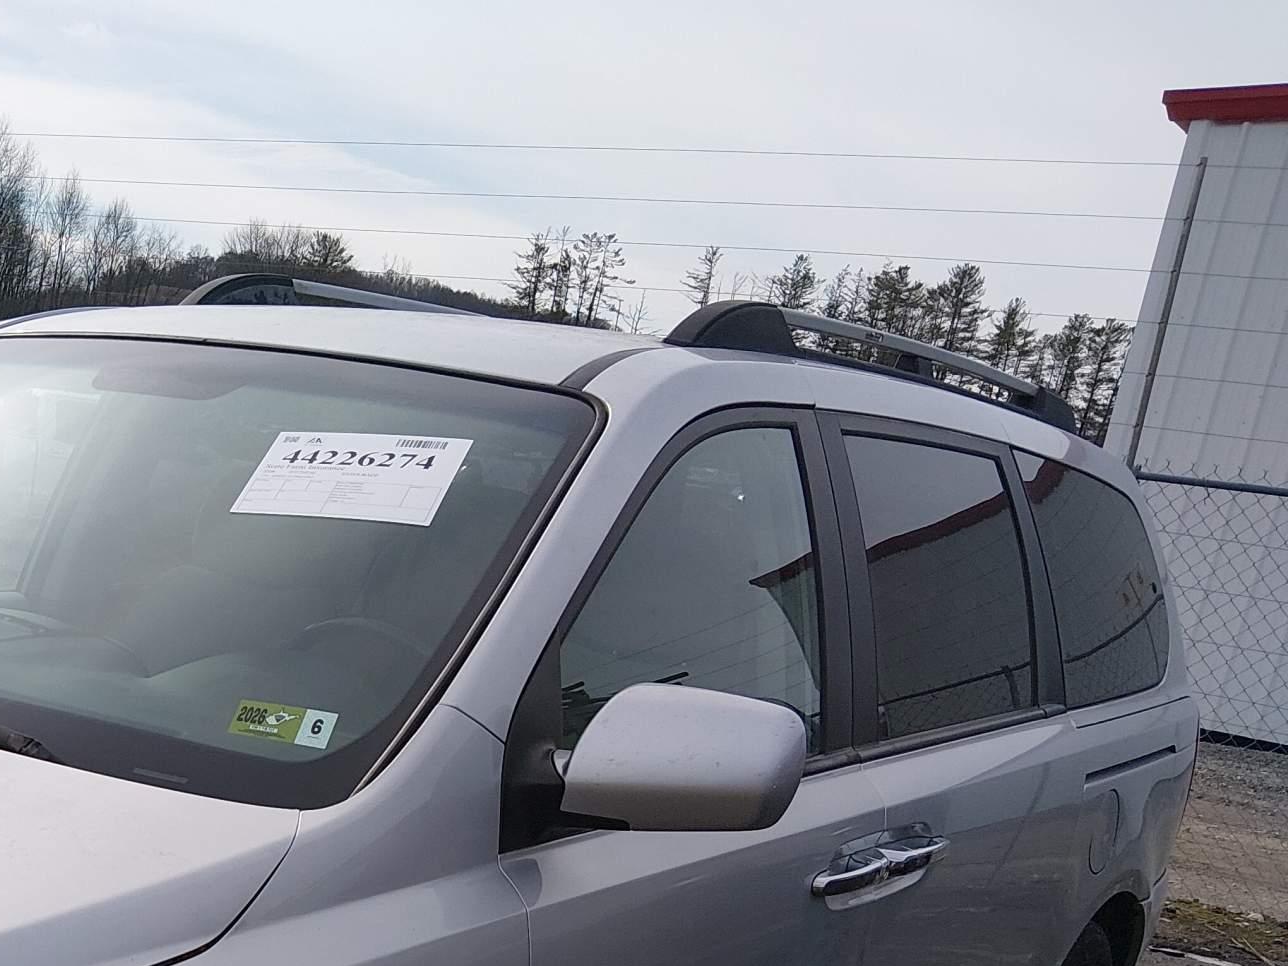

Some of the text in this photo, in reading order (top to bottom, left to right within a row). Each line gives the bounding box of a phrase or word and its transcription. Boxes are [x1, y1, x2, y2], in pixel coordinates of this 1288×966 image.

[282, 449, 436, 470] 44226274
[237, 705, 268, 724] 2026
[310, 718, 324, 735] 6
